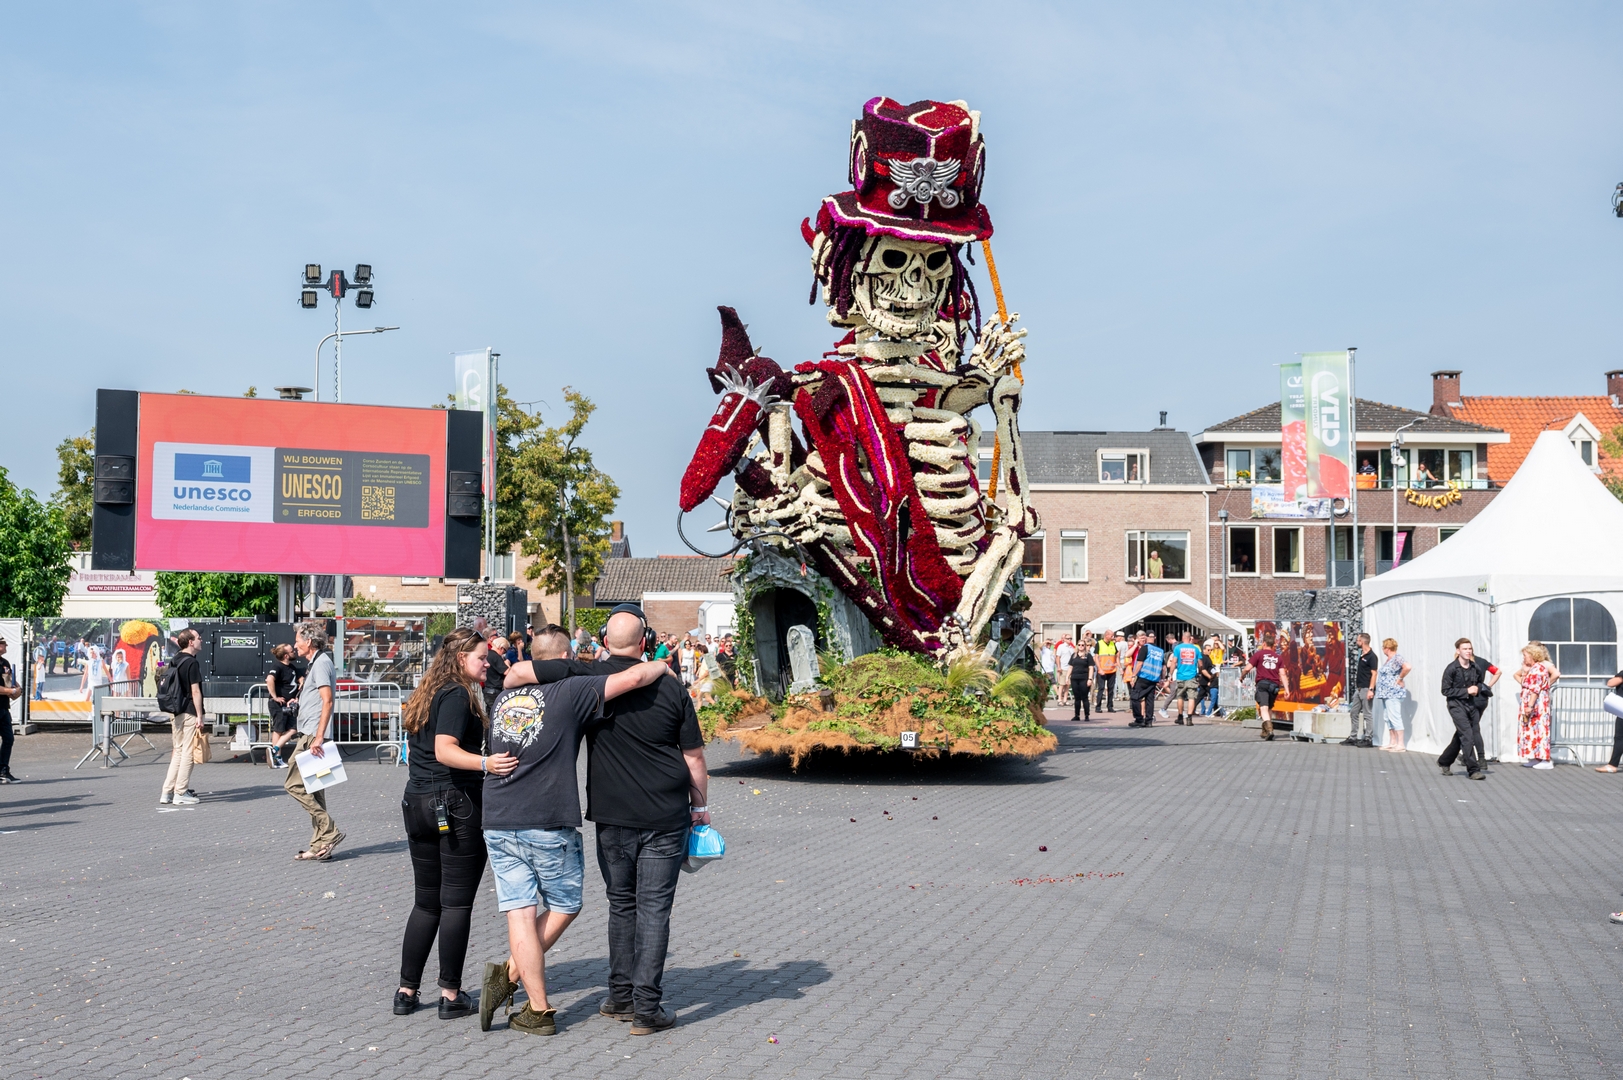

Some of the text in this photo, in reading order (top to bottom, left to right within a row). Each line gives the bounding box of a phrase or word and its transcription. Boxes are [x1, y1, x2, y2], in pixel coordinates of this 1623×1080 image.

[283, 455, 342, 465] WIJ BOUWEN
[282, 473, 342, 500] UNESCO
[173, 486, 252, 502] unesco
[173, 504, 214, 512] Nederlandse
[298, 510, 342, 518] ERFGOED
[902, 734, 914, 742] 05
